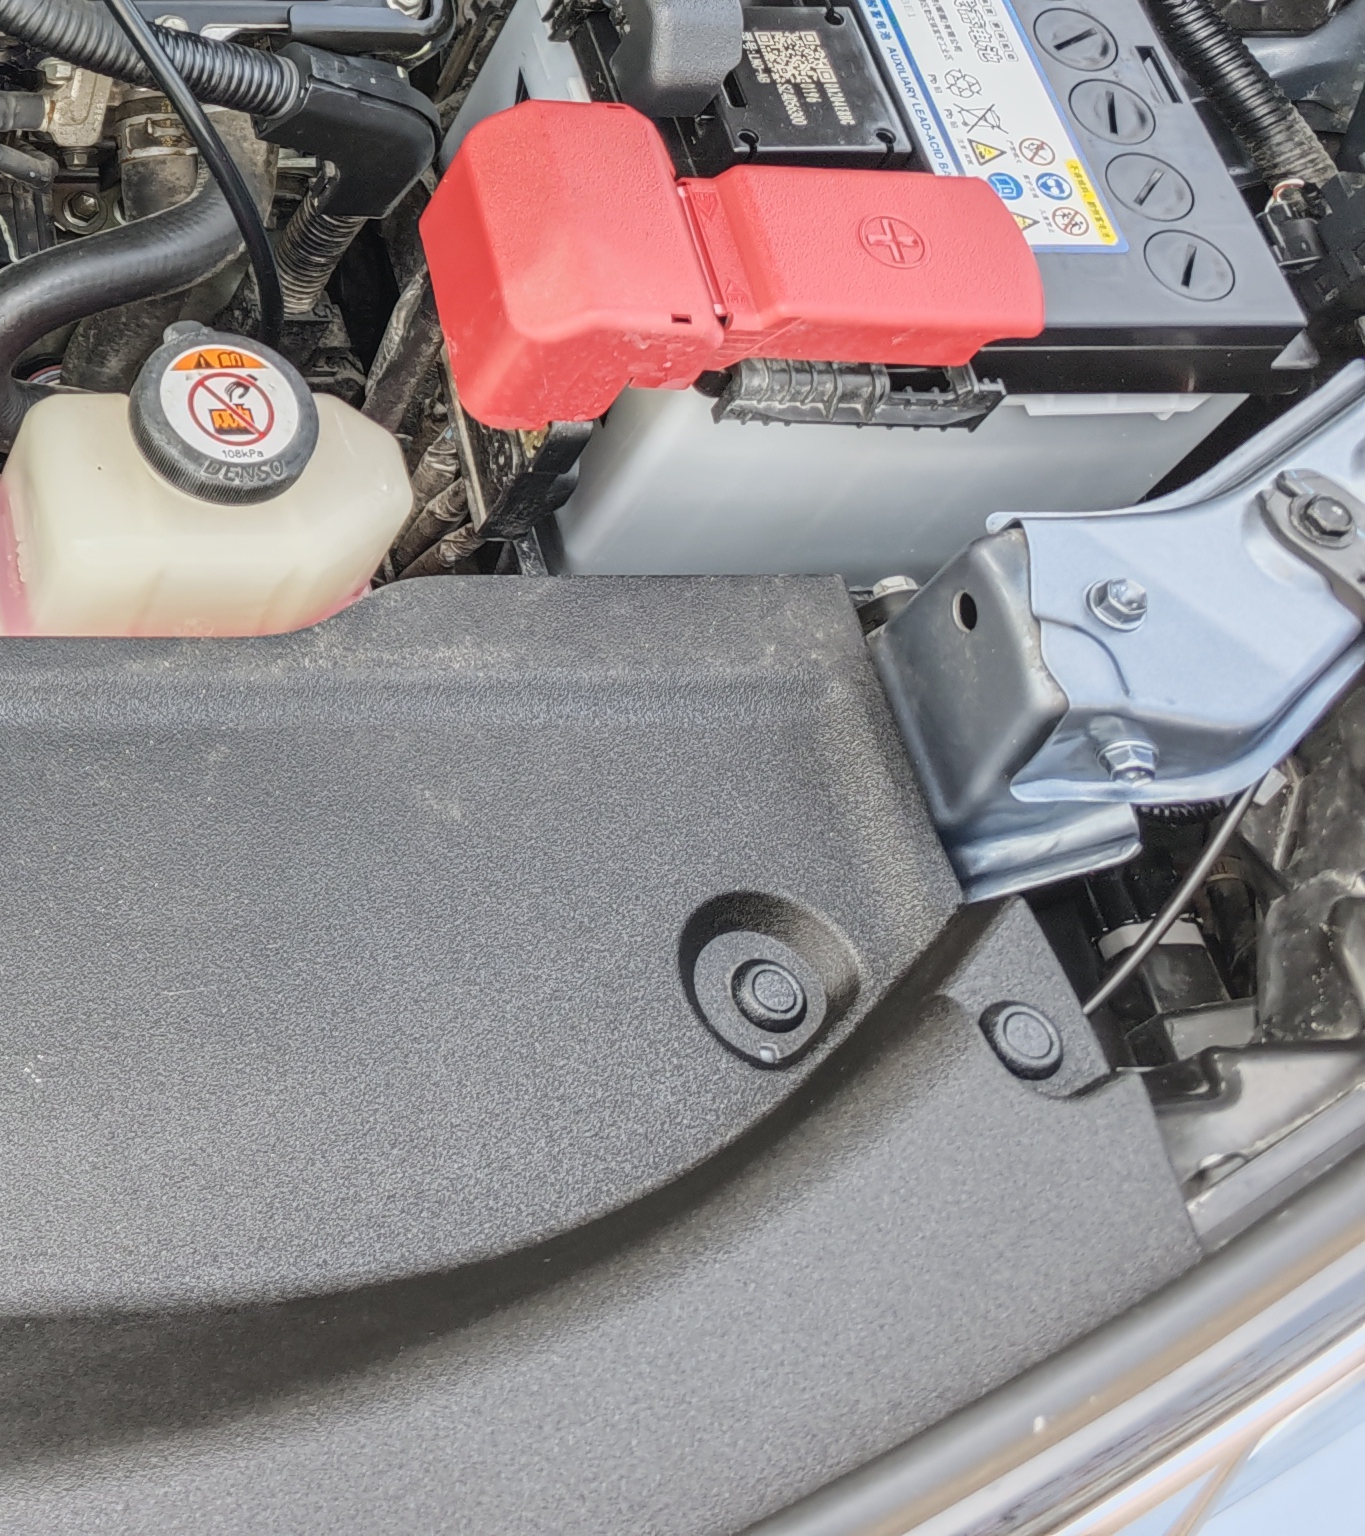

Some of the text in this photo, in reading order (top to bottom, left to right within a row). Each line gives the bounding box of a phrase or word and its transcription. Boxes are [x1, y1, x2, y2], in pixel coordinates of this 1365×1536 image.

[886, 45, 919, 101] AUXILIARY
[911, 102, 945, 164] LEAD-ACID
[221, 448, 265, 459] 108kPa
[199, 459, 286, 483] DENSO
